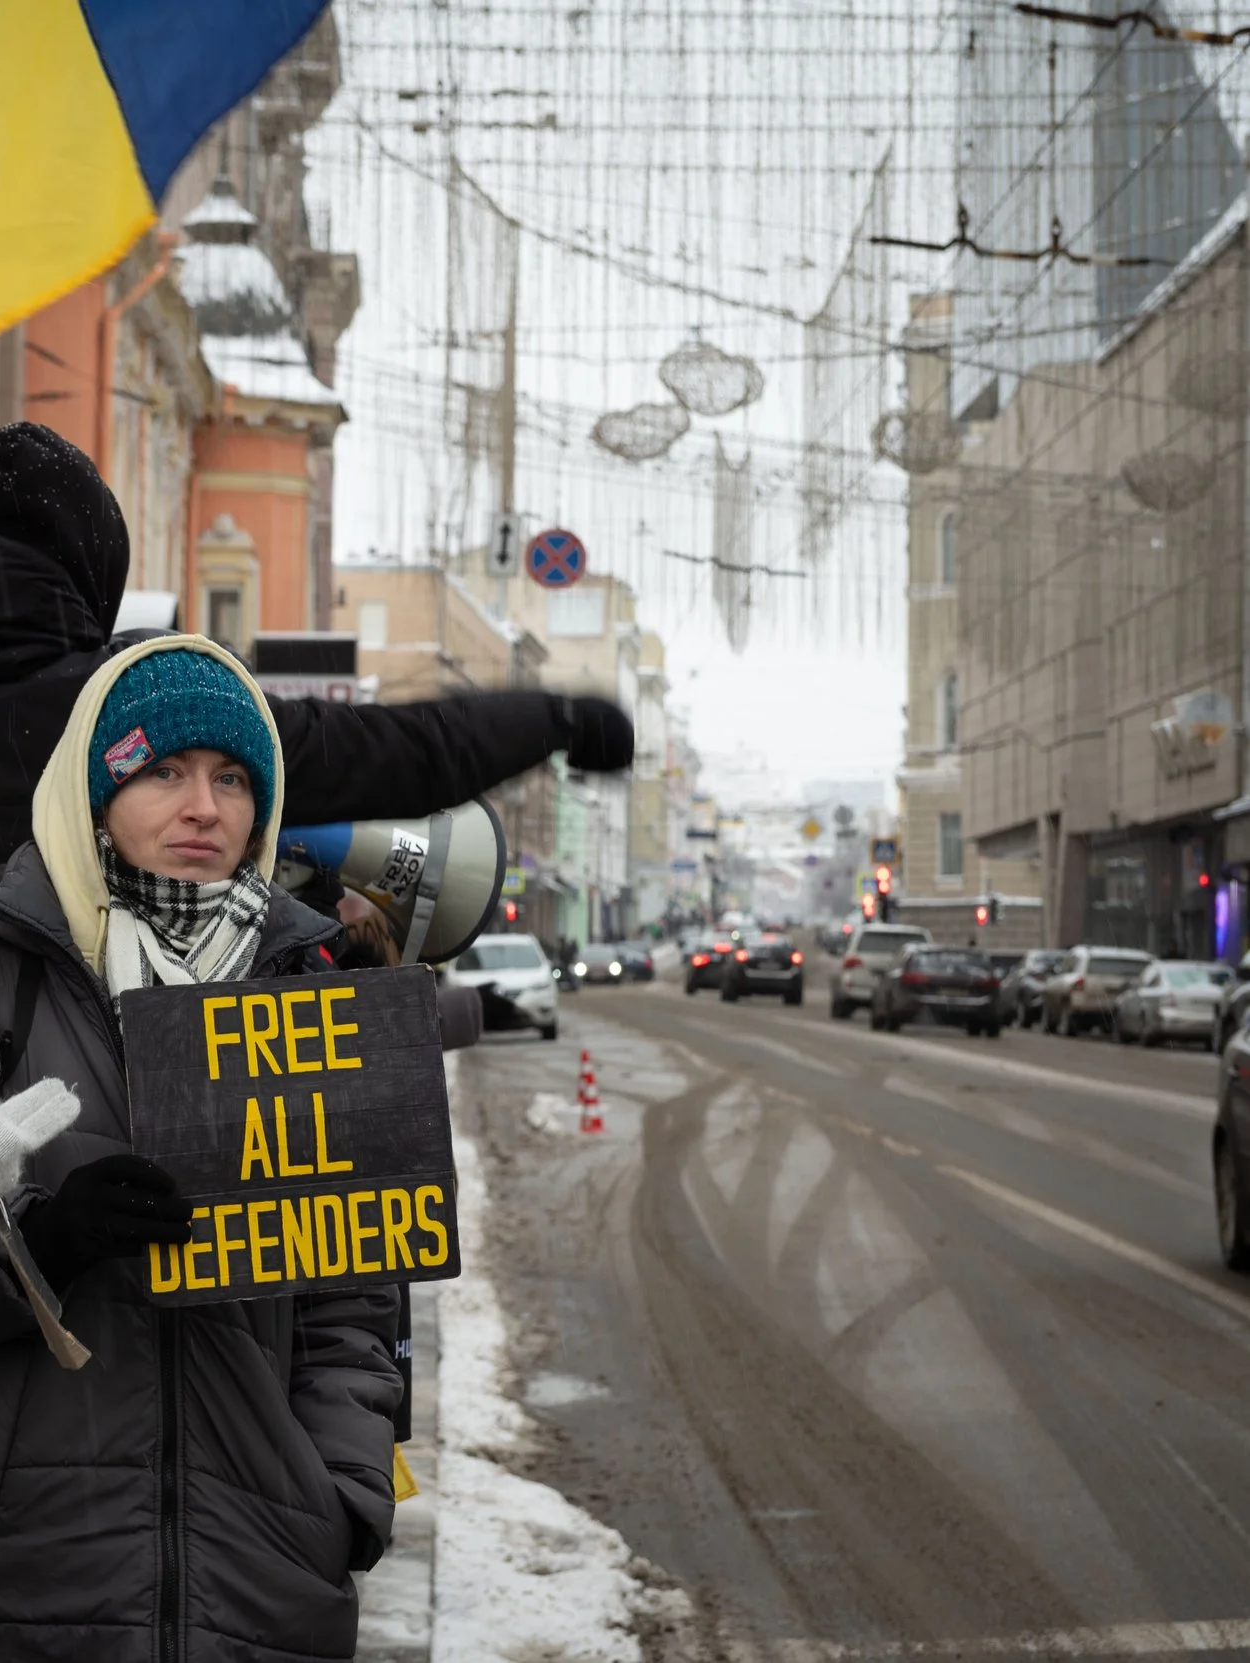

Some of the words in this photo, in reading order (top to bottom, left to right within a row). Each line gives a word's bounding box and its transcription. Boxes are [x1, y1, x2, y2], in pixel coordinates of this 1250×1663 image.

[377, 837, 412, 891] FREE
[392, 844, 425, 898] AZOV
[202, 986, 363, 1081] FREE
[240, 1092, 354, 1181] ALL
